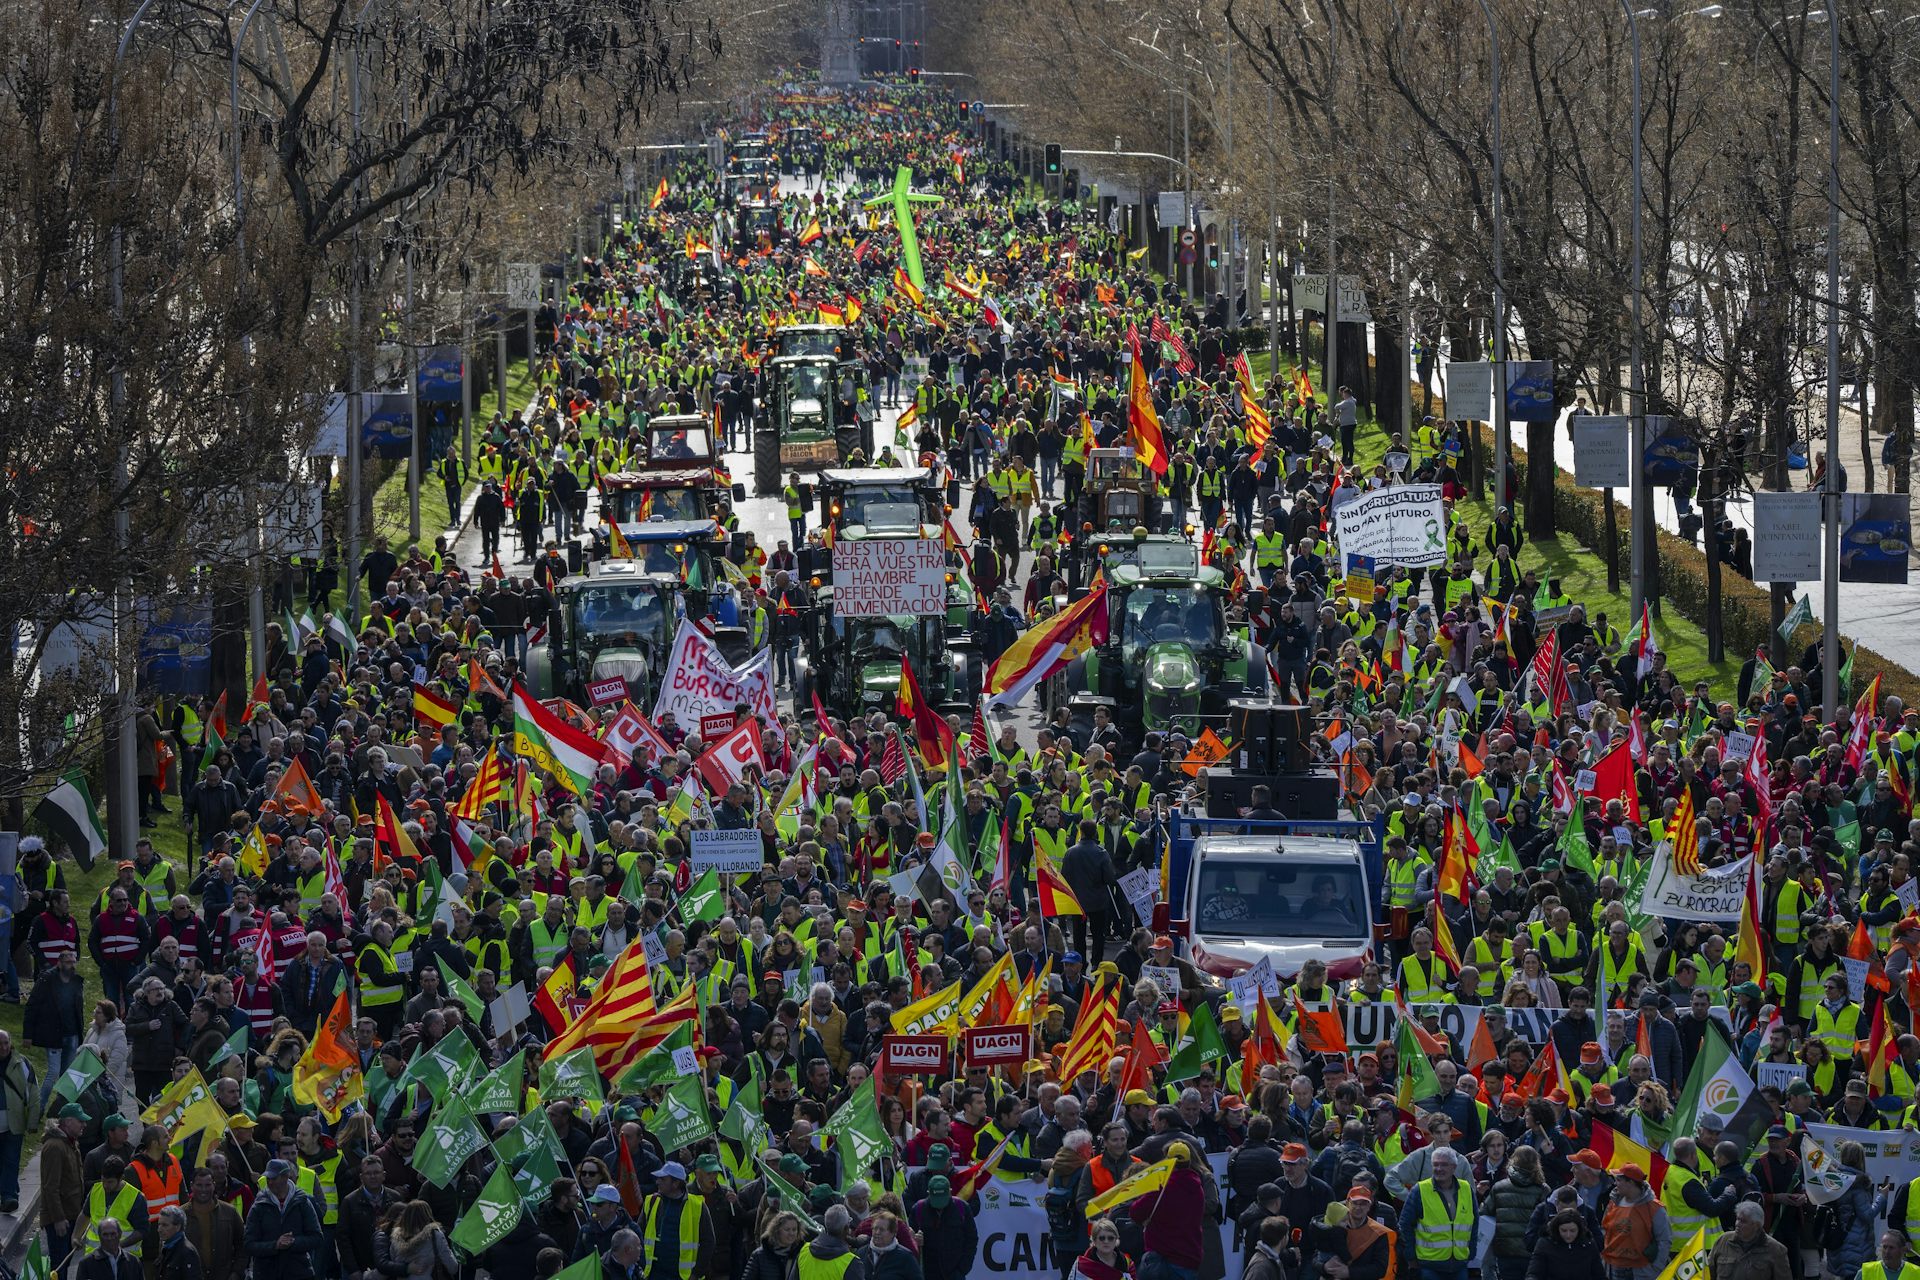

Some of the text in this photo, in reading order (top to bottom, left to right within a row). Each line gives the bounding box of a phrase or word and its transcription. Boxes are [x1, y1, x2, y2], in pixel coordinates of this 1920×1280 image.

[1294, 278, 1325, 287] MAD
[1305, 285, 1325, 296] RID
[1340, 508, 1358, 520] SIN
[1343, 524, 1361, 535] NO
[1773, 523, 1801, 531] ISABEL
[1756, 533, 1818, 542] QUINTANILLA
[833, 540, 944, 556] NUESTRO FIN
[833, 555, 945, 571] SERA VUESTRA
[852, 570, 917, 585] HAMBRE
[834, 584, 941, 600] DEFIENDE TU
[834, 599, 947, 615] ALIMENTACION
[593, 682, 622, 696] UAGN
[705, 719, 733, 731] UAGN
[695, 831, 758, 842] LOS LABRADORES
[722, 861, 760, 871] LLORANDO
[239, 934, 258, 945] UAG
[974, 1034, 1021, 1050] UAGN
[892, 1046, 940, 1058] UAGN
